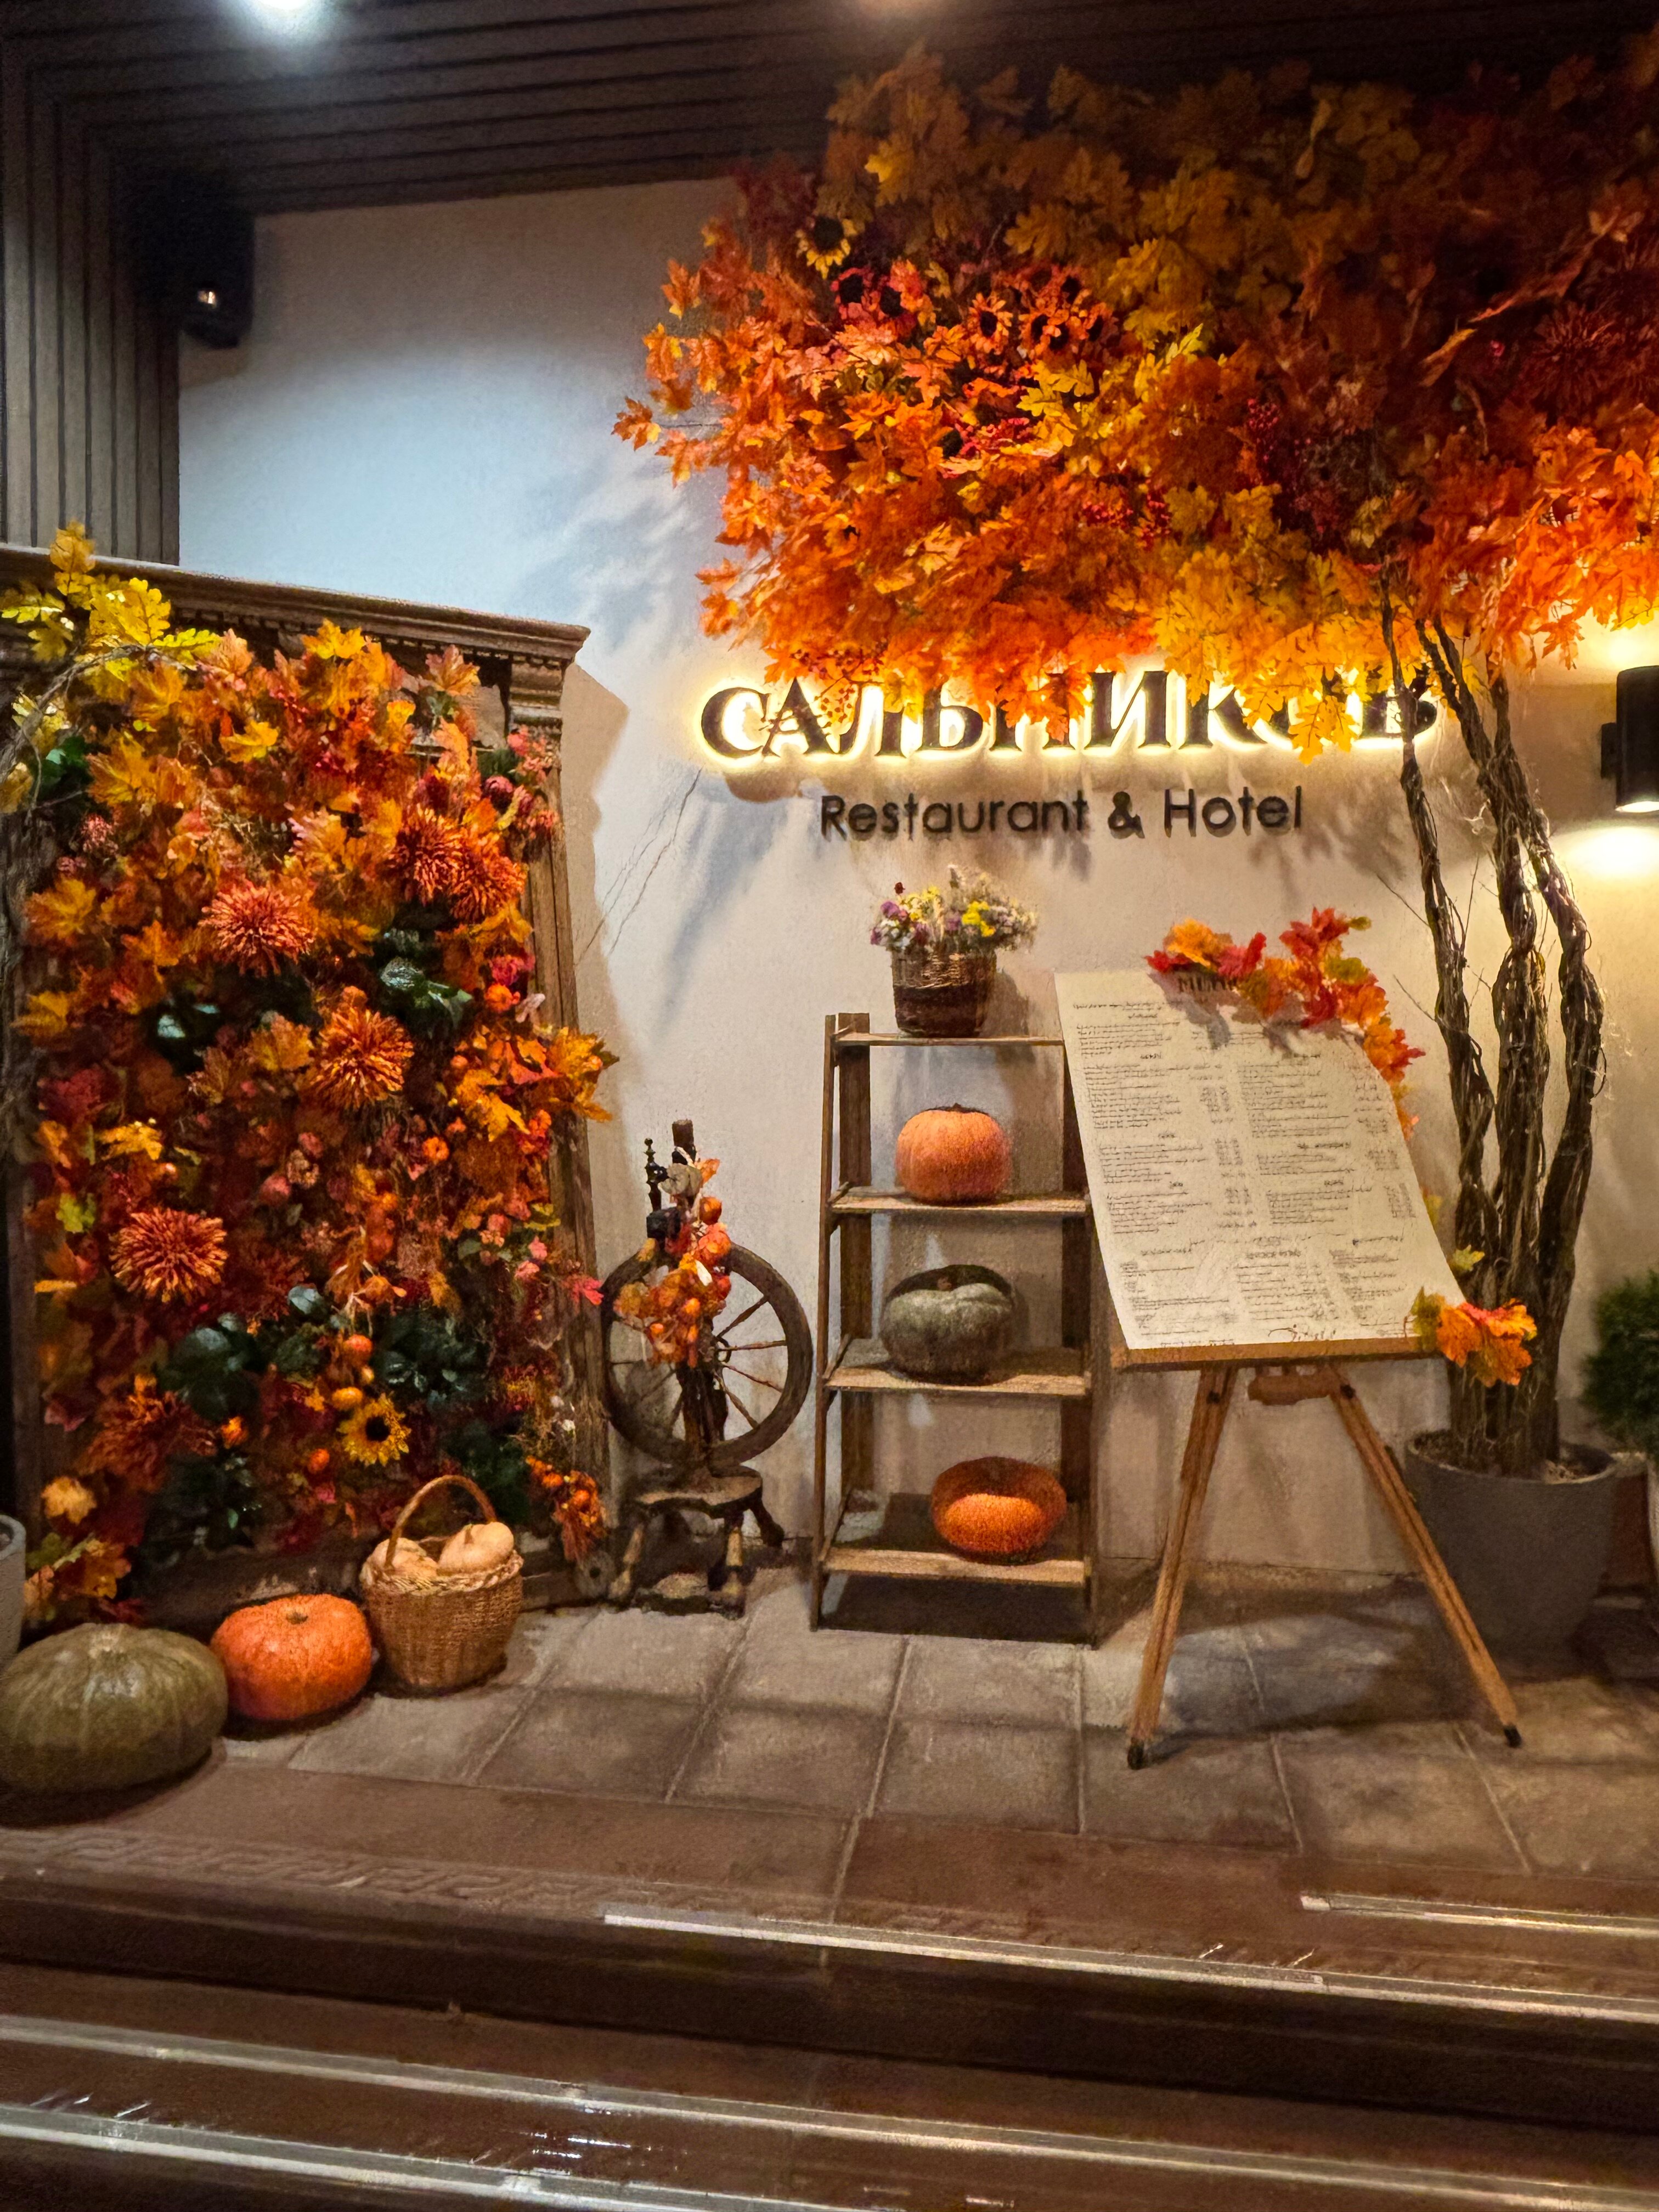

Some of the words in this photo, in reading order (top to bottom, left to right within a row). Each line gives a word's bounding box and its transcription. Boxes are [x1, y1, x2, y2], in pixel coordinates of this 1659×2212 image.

[701, 665, 1437, 757] САЛЬНИКВ
[821, 790, 1088, 840] Restaurant
[1107, 791, 1145, 839] &
[1164, 786, 1302, 838] Hotel
